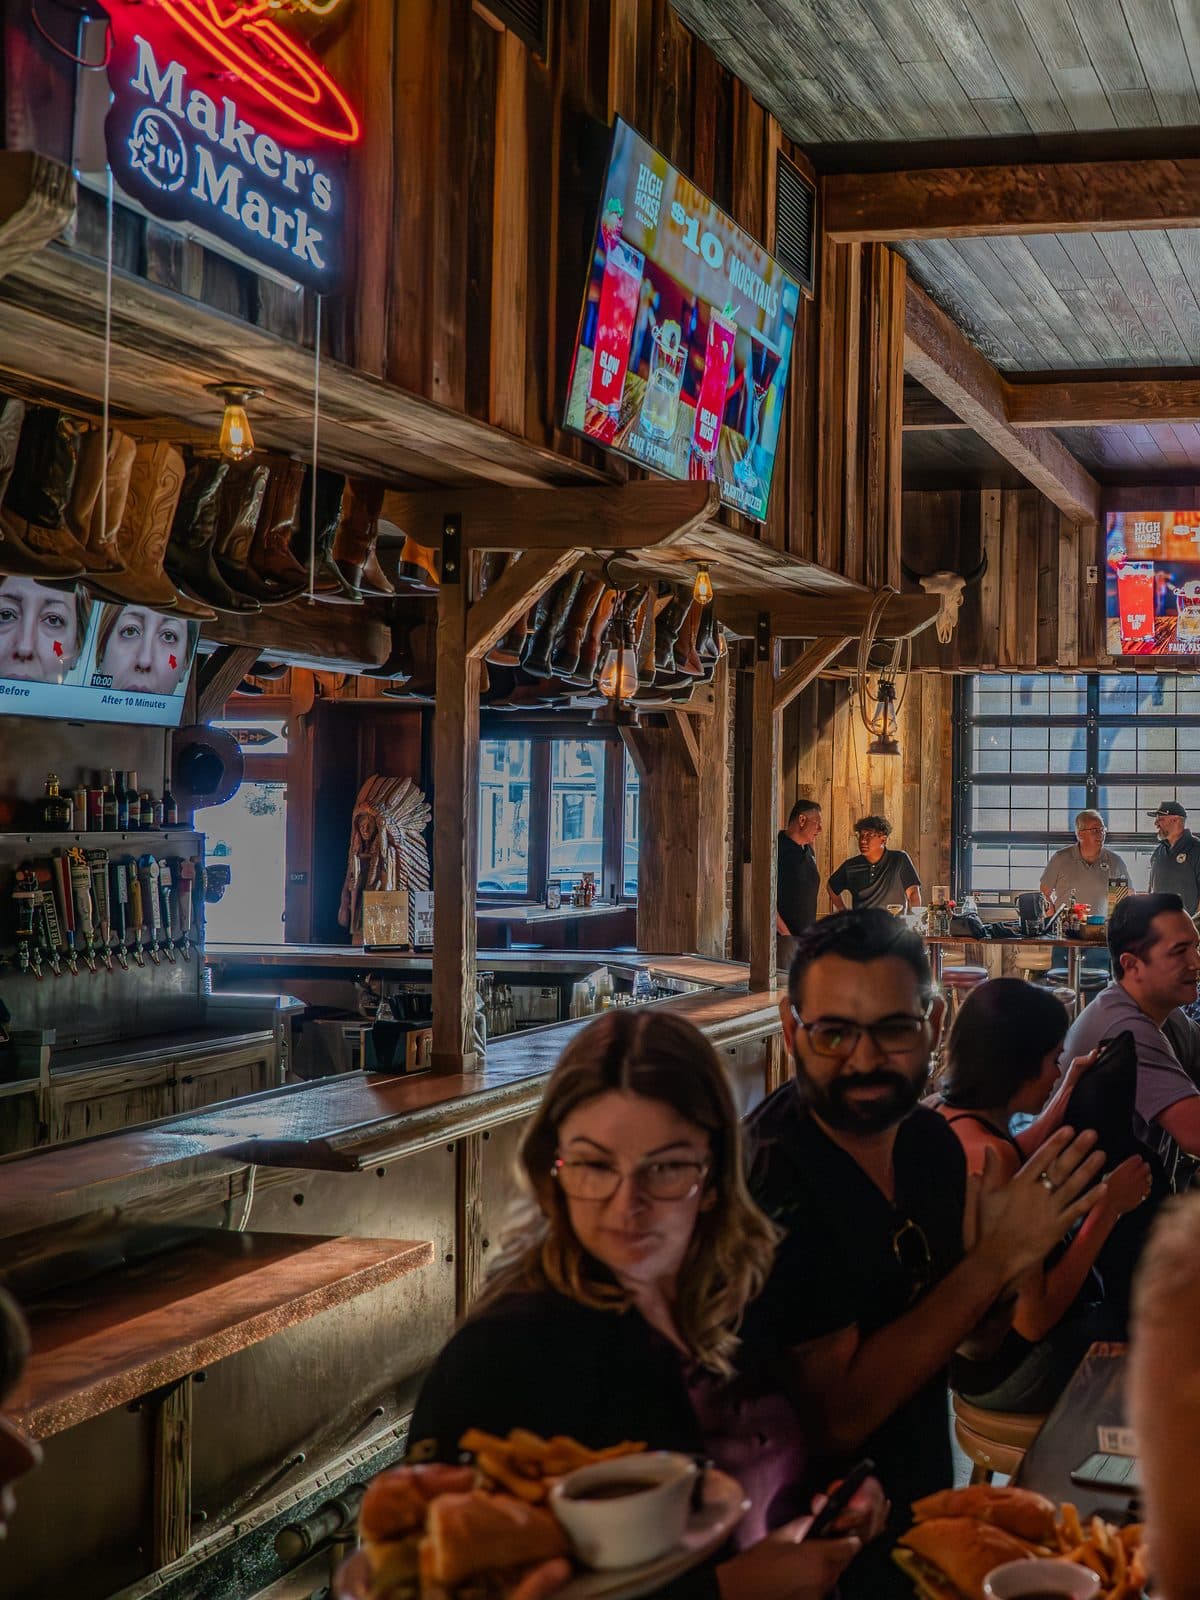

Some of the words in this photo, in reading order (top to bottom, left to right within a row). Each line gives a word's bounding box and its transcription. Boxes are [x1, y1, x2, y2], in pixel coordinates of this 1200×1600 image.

[131, 35, 333, 212] Maker's
[637, 163, 663, 200] HIGH
[191, 146, 325, 270] Mark
[634, 190, 661, 227] HORSE
[671, 201, 724, 269] $10
[728, 255, 779, 319] MOCKTAILS
[600, 350, 620, 375] GLOW
[602, 369, 613, 387] UP
[1135, 522, 1160, 534] HIGH
[1135, 532, 1161, 545] HORSE
[0, 685, 30, 697] Before
[92, 675, 113, 687] 10:00
[101, 694, 122, 706] After
[124, 696, 134, 707] 10
[134, 698, 167, 709] Minutes
